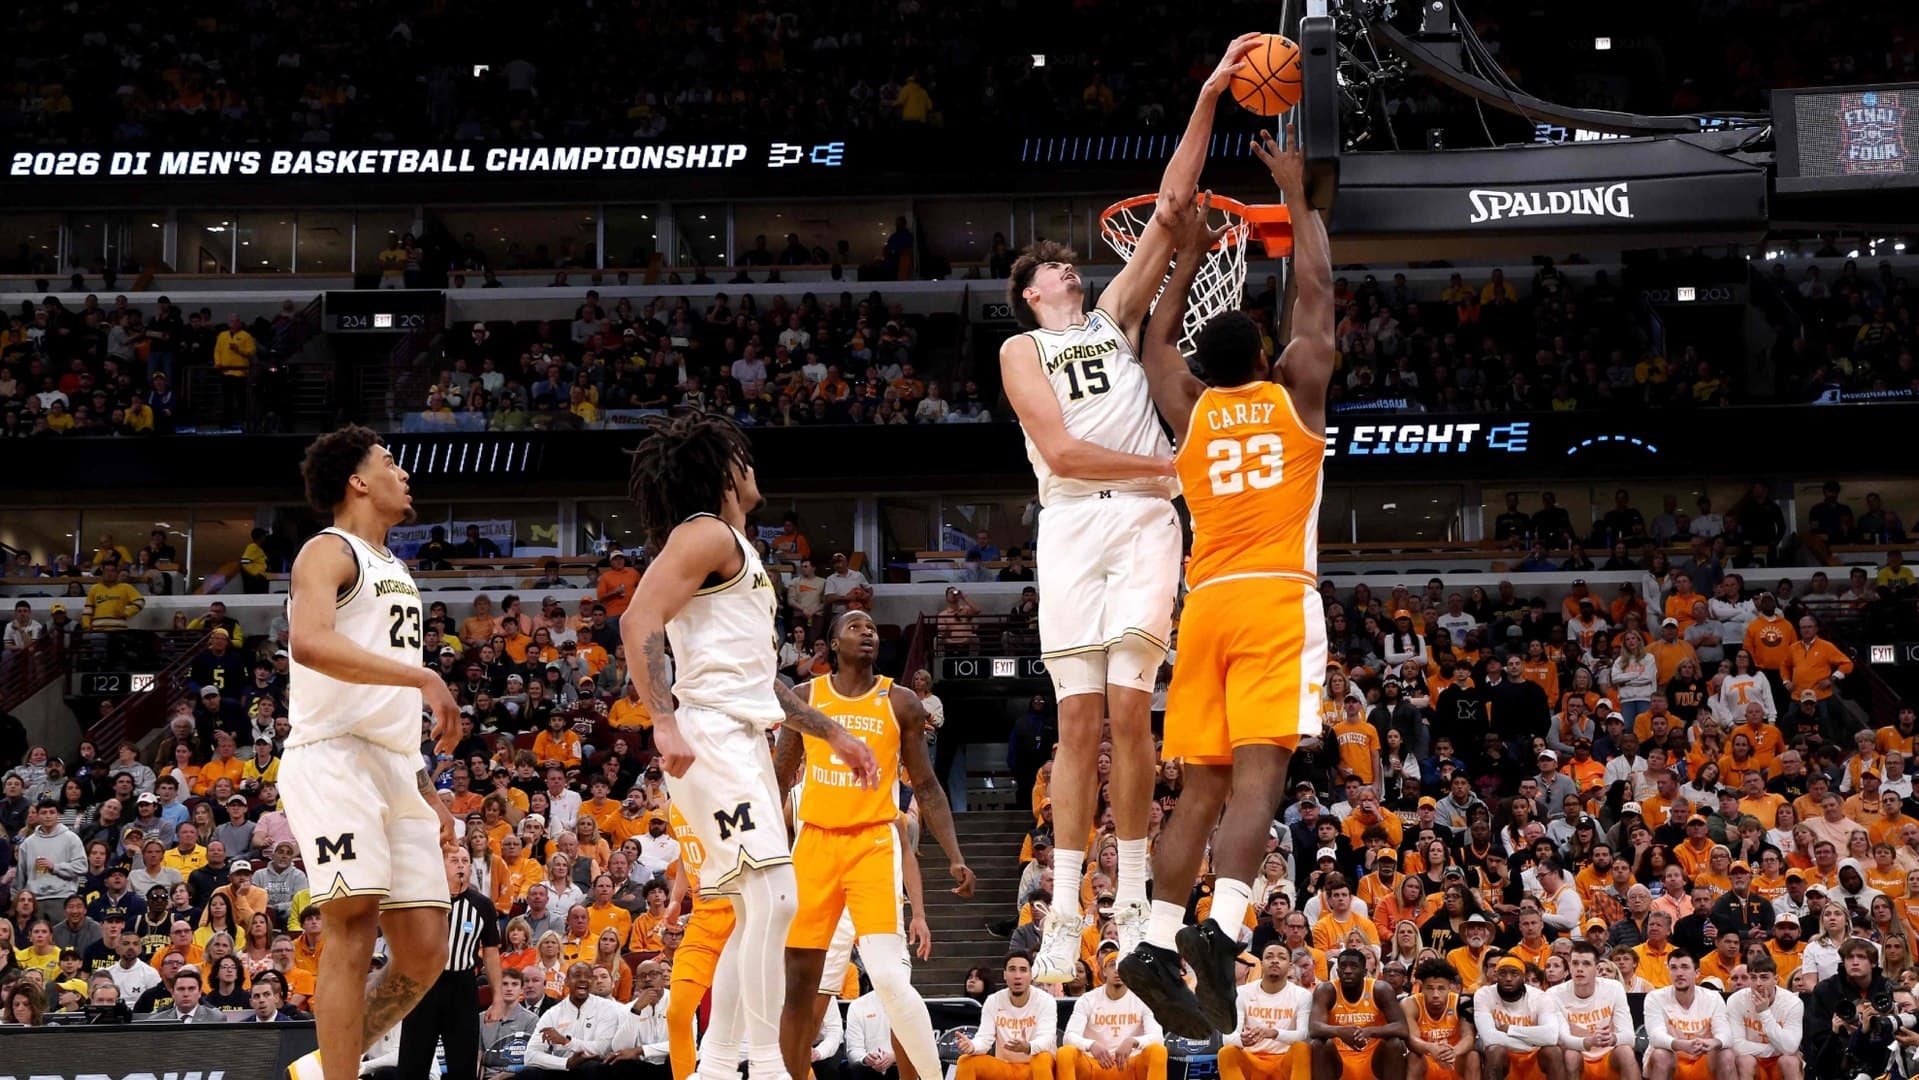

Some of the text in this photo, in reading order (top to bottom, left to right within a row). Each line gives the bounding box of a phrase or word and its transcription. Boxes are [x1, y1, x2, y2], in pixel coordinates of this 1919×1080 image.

[1845, 108, 1898, 127] FINAL
[11, 144, 747, 175] 2026 DI MEN'S BASKETBALL CHAMPIONSHIP
[1848, 143, 1902, 161] FOUR
[1468, 181, 1632, 223] SPALDING
[1045, 338, 1110, 375] MICHIGAN
[1074, 358, 1122, 402] 15
[1204, 404, 1272, 431] CAREY
[1349, 423, 1480, 456] EIGHT
[1202, 433, 1282, 497] 23
[1098, 490, 1111, 499] M
[388, 605, 423, 649] 23
[1872, 646, 1893, 661] EXIT
[953, 660, 977, 675] 101
[992, 660, 1013, 676] EXIT
[93, 676, 118, 691] 122
[213, 669, 224, 689] 5
[1729, 682, 1754, 705] T
[1456, 699, 1479, 720] M
[714, 802, 756, 841] M
[316, 833, 355, 864] M
[1750, 902, 1760, 914] T
[1094, 1014, 1118, 1026] LOCK
[1247, 1006, 1272, 1019] LOCK
[1335, 1013, 1376, 1024] TENNESSEE
[1567, 1011, 1591, 1023] LOCK
[1111, 1027, 1121, 1037] T
